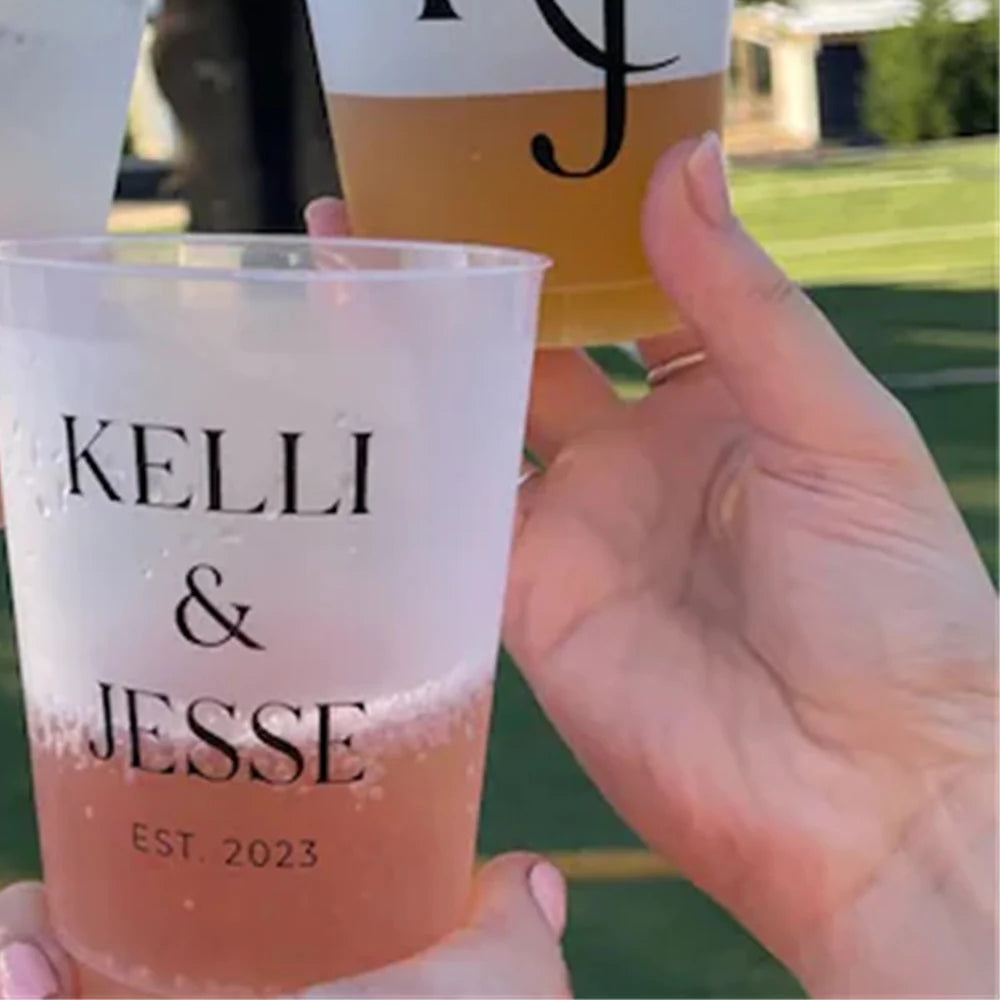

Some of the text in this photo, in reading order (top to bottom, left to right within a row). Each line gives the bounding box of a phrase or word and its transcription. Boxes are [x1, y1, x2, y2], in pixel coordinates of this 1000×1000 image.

[61, 414, 374, 516] KELLI
[174, 562, 267, 652] &
[88, 681, 368, 787] JESSE
[132, 822, 319, 870] EST. 2023
